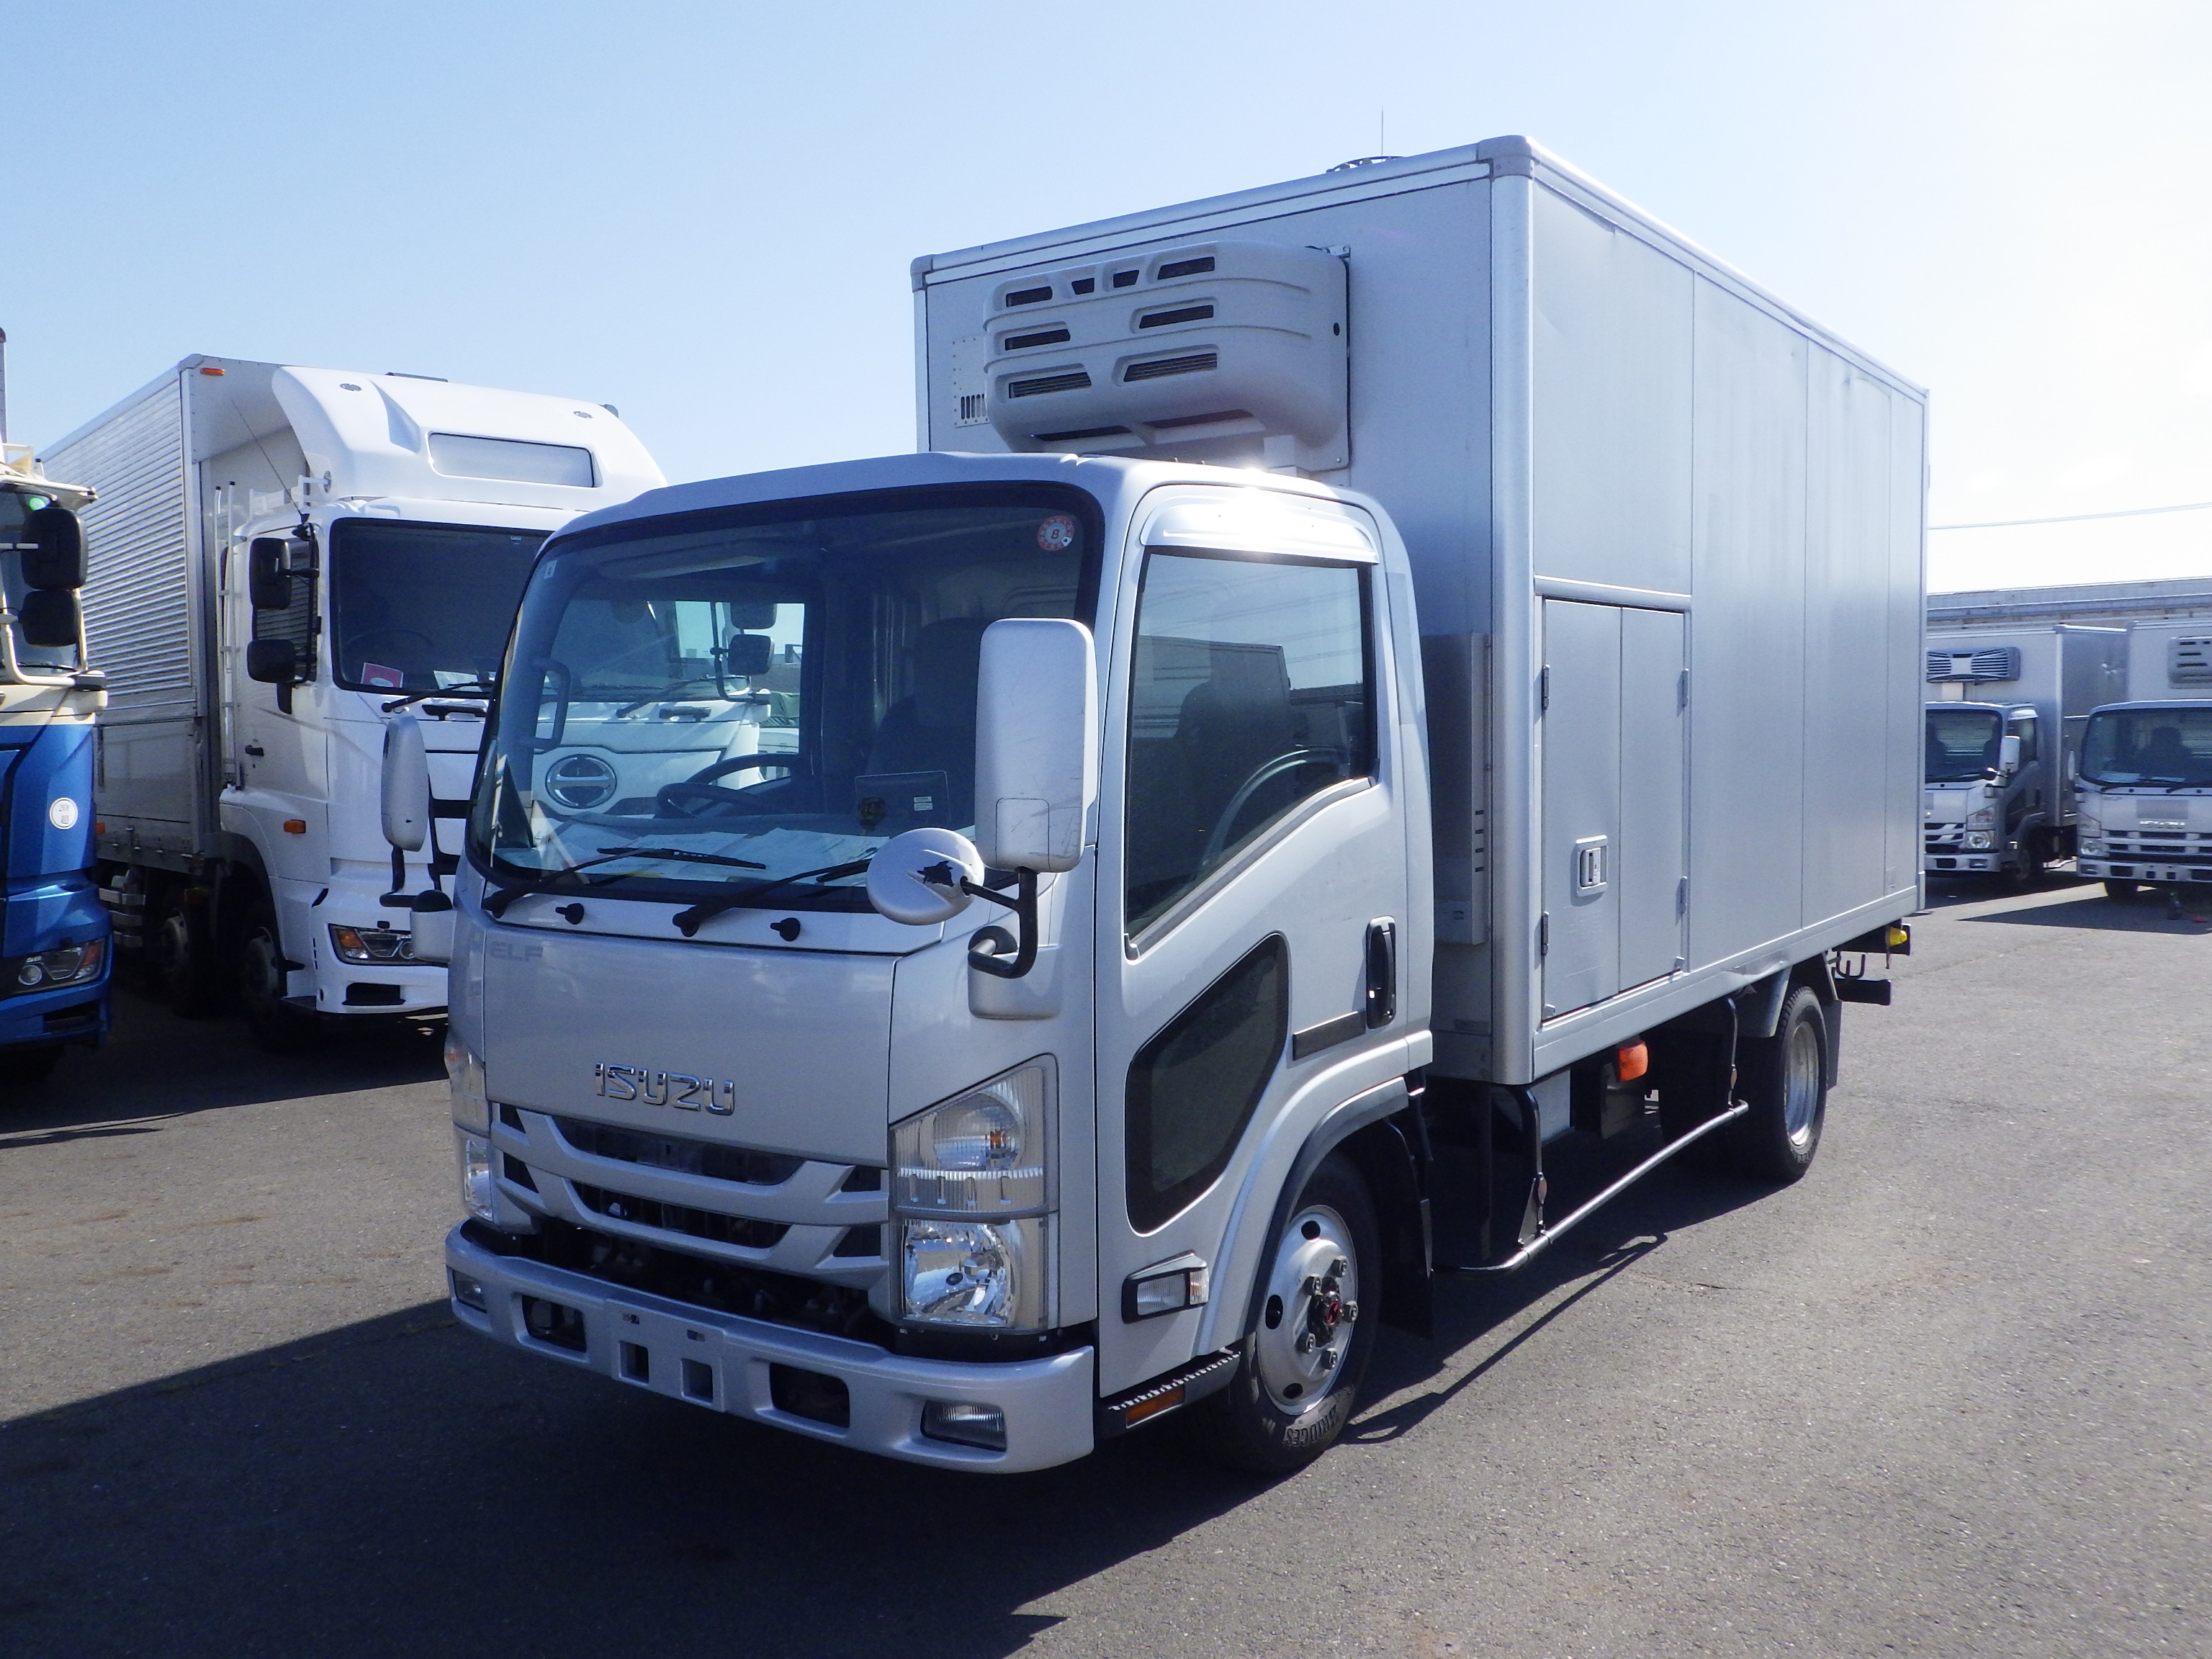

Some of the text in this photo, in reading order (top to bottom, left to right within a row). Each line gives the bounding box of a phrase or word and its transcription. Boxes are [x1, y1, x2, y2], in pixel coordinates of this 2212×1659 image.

[1051, 529, 1059, 539] 8
[490, 941, 544, 962] ELF
[595, 1061, 735, 1116] ISUZU
